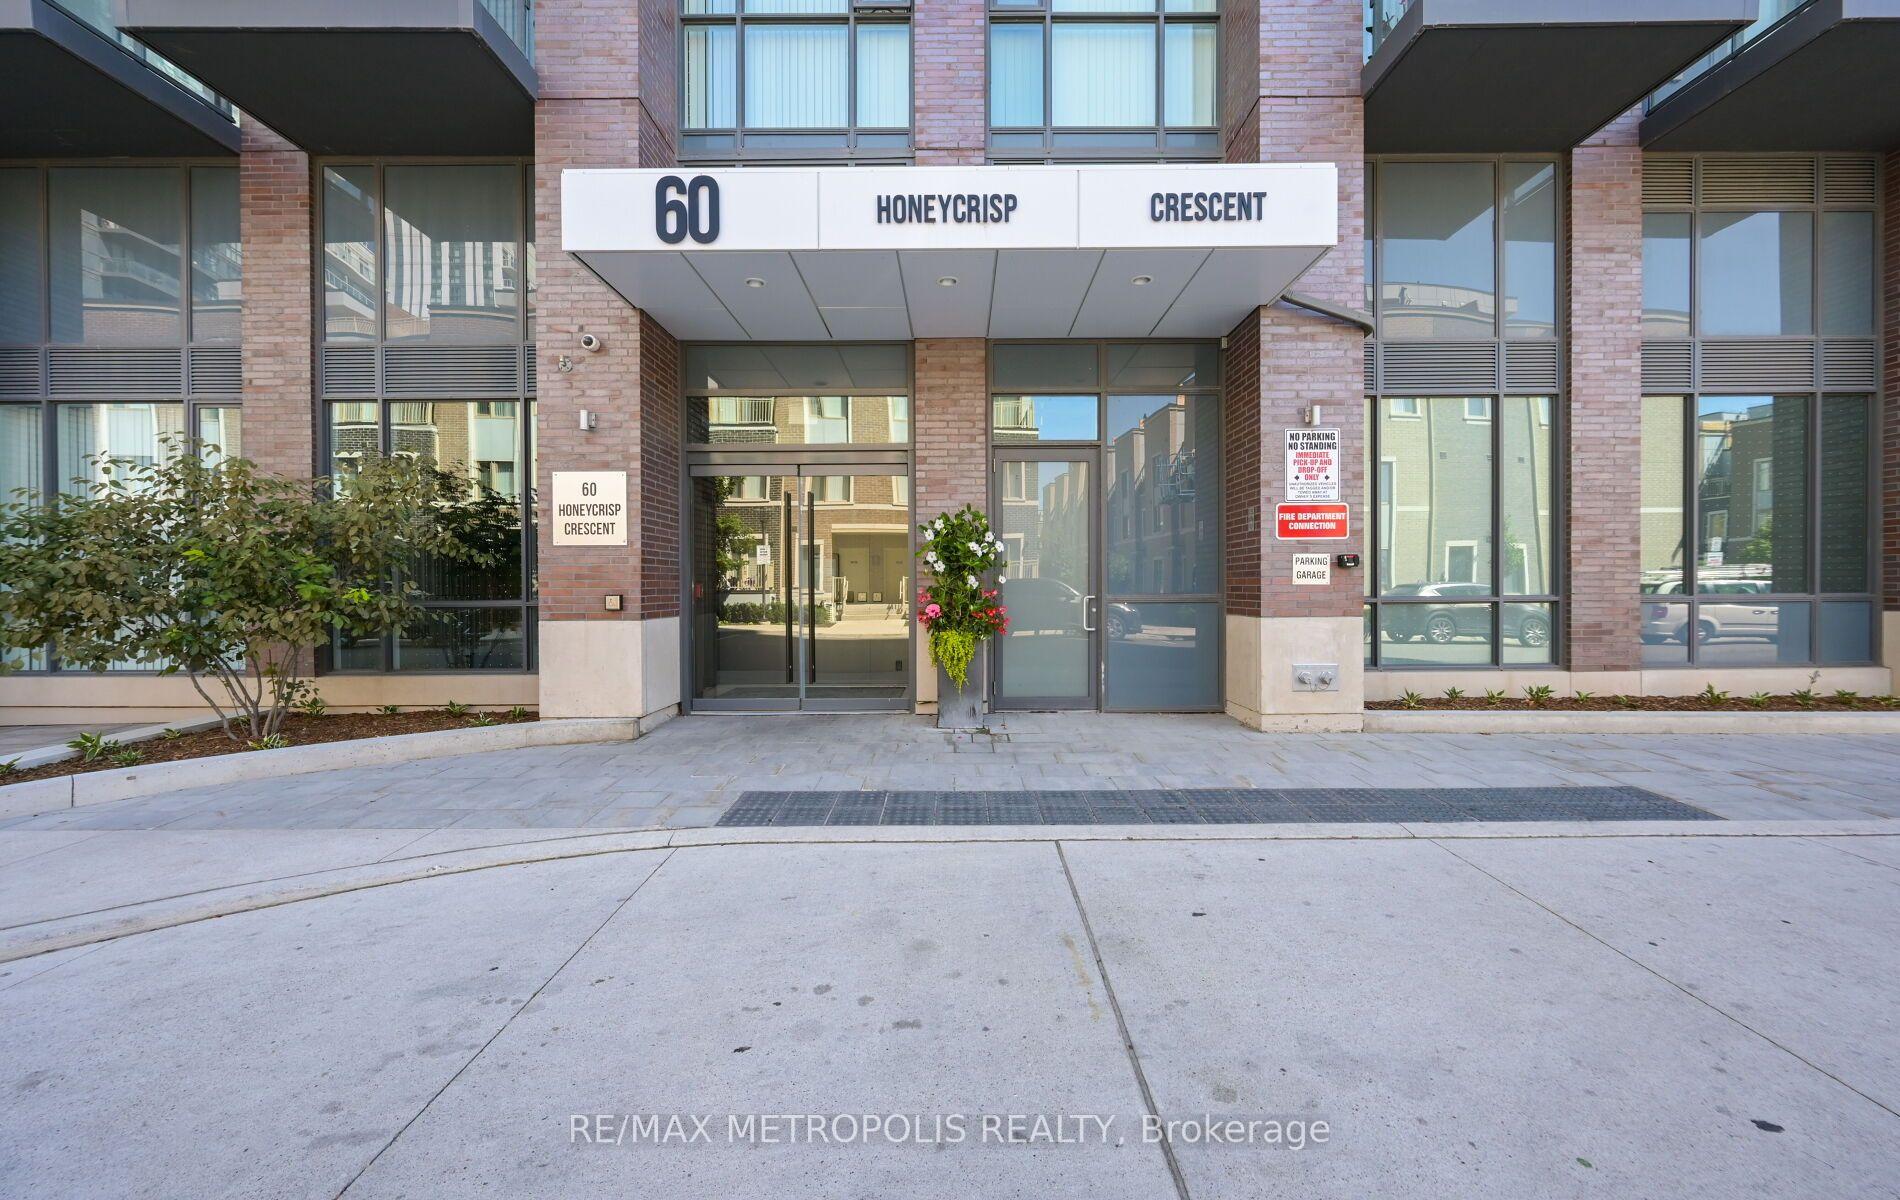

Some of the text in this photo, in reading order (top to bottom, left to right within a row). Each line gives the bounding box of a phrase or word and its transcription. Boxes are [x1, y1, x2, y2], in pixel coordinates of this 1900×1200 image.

[655, 175, 1267, 245] 60 HONEYCRISP CRESCENT
[1290, 432, 1336, 441] NO PARKING
[1288, 442, 1337, 450] NO STANDING
[582, 482, 597, 497] 60
[558, 503, 622, 517] HONEYCRISP
[1297, 512, 1346, 520] DEPARTMENT
[564, 522, 616, 536] CRESCENT
[1288, 522, 1336, 530] CONNECTION
[1295, 556, 1328, 566] PARKING
[1296, 570, 1326, 579] GARAGE
